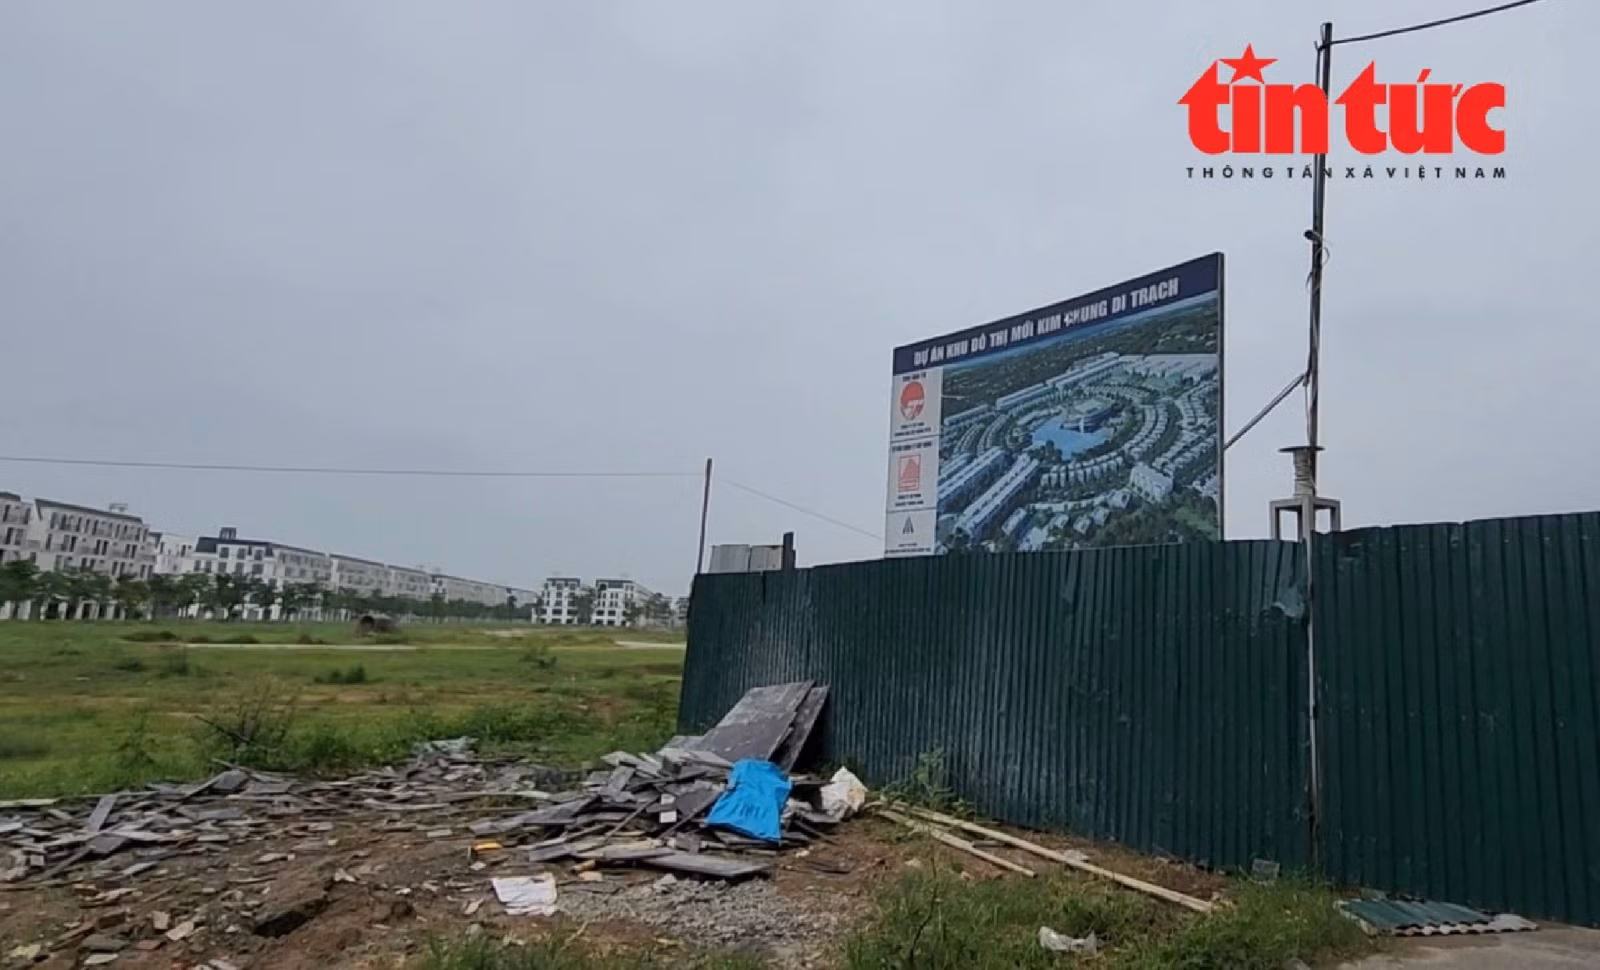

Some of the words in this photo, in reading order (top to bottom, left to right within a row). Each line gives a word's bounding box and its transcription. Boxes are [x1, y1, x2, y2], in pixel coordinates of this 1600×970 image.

[946, 340, 968, 359] KHU
[1011, 320, 1034, 342] MỚI
[1037, 314, 1061, 335] KIM
[1111, 294, 1127, 314] DI
[1130, 277, 1179, 308] TRẠCH
